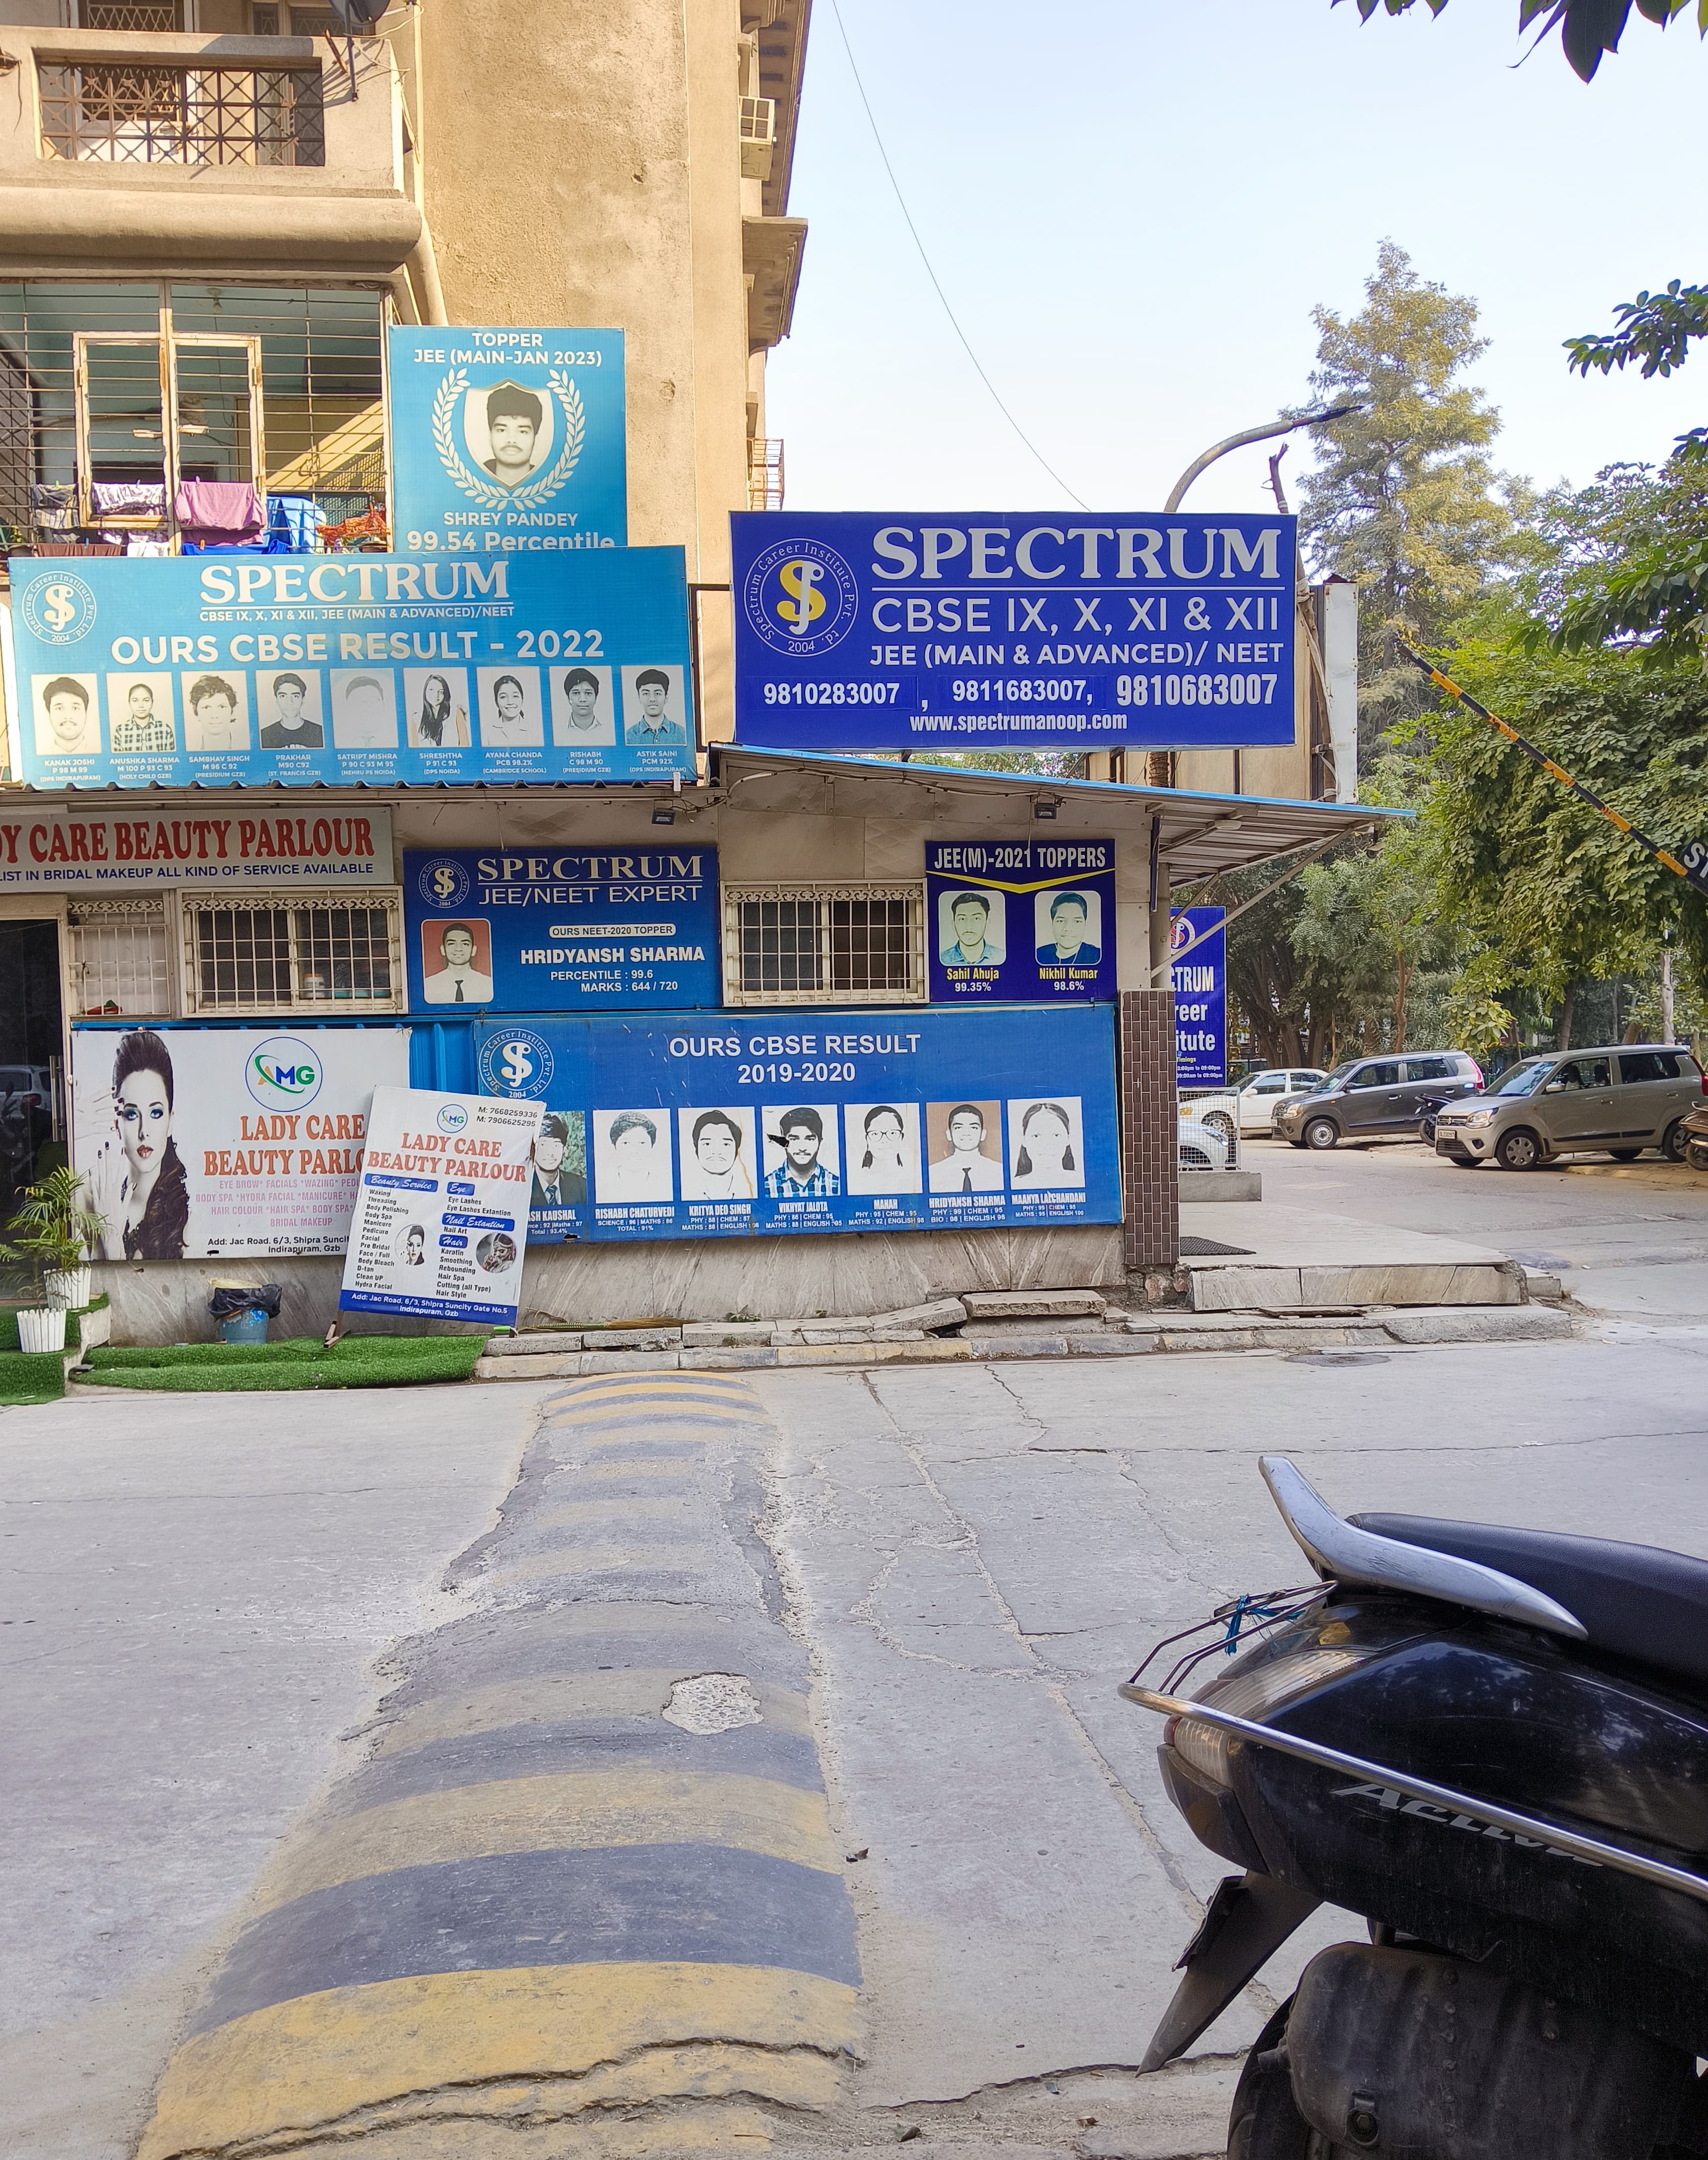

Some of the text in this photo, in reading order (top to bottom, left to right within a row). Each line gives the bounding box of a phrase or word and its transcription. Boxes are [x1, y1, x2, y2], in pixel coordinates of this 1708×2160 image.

[472, 332, 543, 346] TOPPER
[414, 349, 602, 367] JEE (MAIN-JAN 2023)
[443, 512, 578, 527] SHREY PANDEY
[407, 530, 615, 551] 99.54 Percentile
[758, 544, 800, 571] Career
[872, 526, 1281, 579] SPECTRUM
[805, 542, 851, 589] Institute
[200, 561, 509, 604] SPECTRUM
[199, 611, 233, 621] CBSE
[237, 611, 252, 621] IX,
[255, 611, 267, 621] X,
[270, 610, 283, 620] XI
[286, 610, 295, 620] &
[298, 610, 318, 621] XII,
[322, 609, 344, 620] JEE
[347, 608, 385, 620] (MAIN
[389, 608, 398, 618] &
[750, 574, 775, 640] Spectrum
[872, 596, 1277, 636] CBSE IX, X, XI & XII
[111, 635, 218, 664] OURS
[229, 633, 328, 662] CBSE
[340, 631, 478, 660] RESULT
[516, 629, 604, 658] 2022
[788, 640, 815, 653] 2004
[870, 640, 1284, 668] JEE (MAIN & ADVANCED)/ NEET
[764, 683, 900, 705] 9810283007
[953, 680, 1093, 706] 9811683007,
[1116, 674, 1278, 706] 9810683007
[910, 712, 1128, 733] www.spectrumanoop.com
[0, 818, 375, 863] Y CARE BEAUTY PARLOUR
[935, 847, 1106, 873] JEE(M)-2021 TOPPERS
[26, 871, 39, 881] IN
[44, 869, 92, 880] BRIDAL
[96, 868, 153, 879] MAKEUP
[157, 867, 182, 878] ALL
[186, 866, 218, 877] KIND
[222, 865, 240, 876] OF
[244, 864, 300, 875] SERVICE
[303, 863, 373, 874] AVAILABLE
[477, 855, 704, 882] SPECTRUM
[479, 885, 703, 907] JEE/NEET EXPERT
[552, 925, 673, 936] OURS NEET-2020 TOPPER
[520, 946, 705, 964] HRIDYANSH SHARMA
[550, 969, 654, 981] PERCENTILE 99.6
[947, 967, 999, 981] Sahil Ahuja
[1039, 967, 1098, 979] Nikhil Kumar
[581, 982, 622, 992] MARKS
[631, 981, 651, 992] 644
[659, 981, 678, 991] 720
[954, 982, 992, 992] 99.35%
[1054, 981, 1084, 991] 98.6%
[669, 1033, 921, 1058] OURS CBSE RESULT
[738, 1063, 856, 1084] 2019-2020
[490, 1108, 537, 1118] 7668259336
[240, 1114, 365, 1141] LADY CARE
[488, 1116, 536, 1127] 7906625295
[401, 1133, 502, 1157] LADY CARE
[204, 1149, 294, 1176] BEAUTY
[367, 1151, 526, 1182] BEAUTY PARLOUR
[371, 1176, 432, 1190] Beauty Service
[450, 1183, 466, 1194] Eye
[779, 1203, 805, 1213] VIKHYAT
[973, 1195, 1006, 1207] SHARMA
[382, 1206, 409, 1214] Polishing
[595, 1207, 675, 1219] RISHABH CHATURVEDI
[689, 1204, 751, 1216] KRITYA DEO SINGH
[270, 1217, 332, 1227] BRIDAL MAKEUP
[294, 1236, 321, 1245] Shipra
[439, 1265, 476, 1274] Rebounding
[440, 1257, 472, 1266] Smoothing
